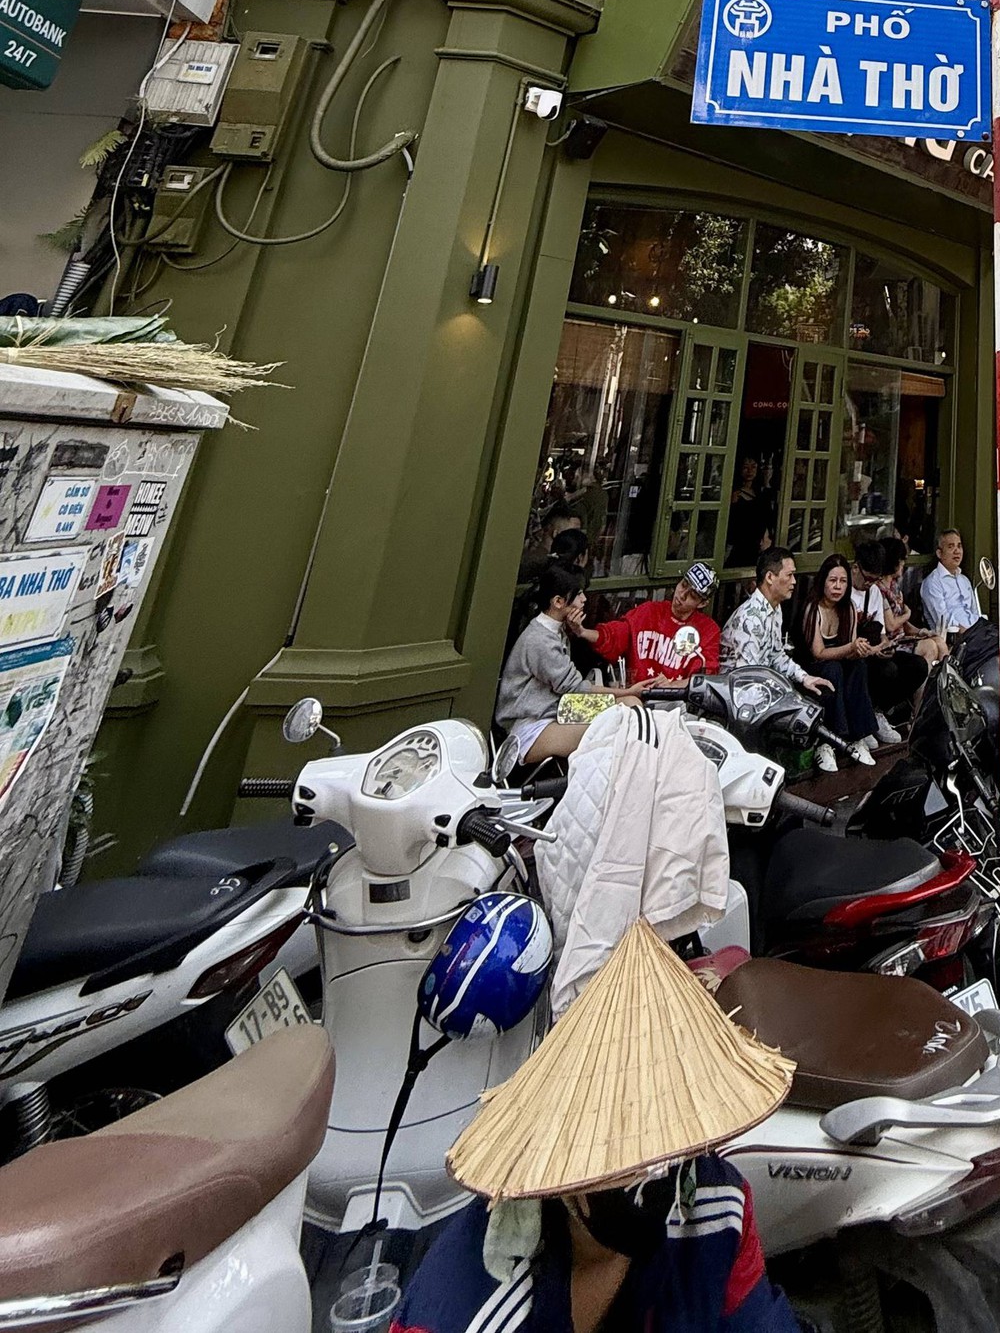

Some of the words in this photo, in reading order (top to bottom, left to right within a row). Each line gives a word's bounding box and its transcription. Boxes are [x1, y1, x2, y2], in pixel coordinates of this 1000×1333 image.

[826, 6, 915, 40] PHỐ
[4, 40, 37, 68] 24/7
[726, 44, 844, 105] NHÀ
[859, 53, 965, 113] THỜ
[124, 514, 155, 536] MEOW
[239, 980, 290, 1045] 17-B9
[766, 1162, 852, 1182] VISION
